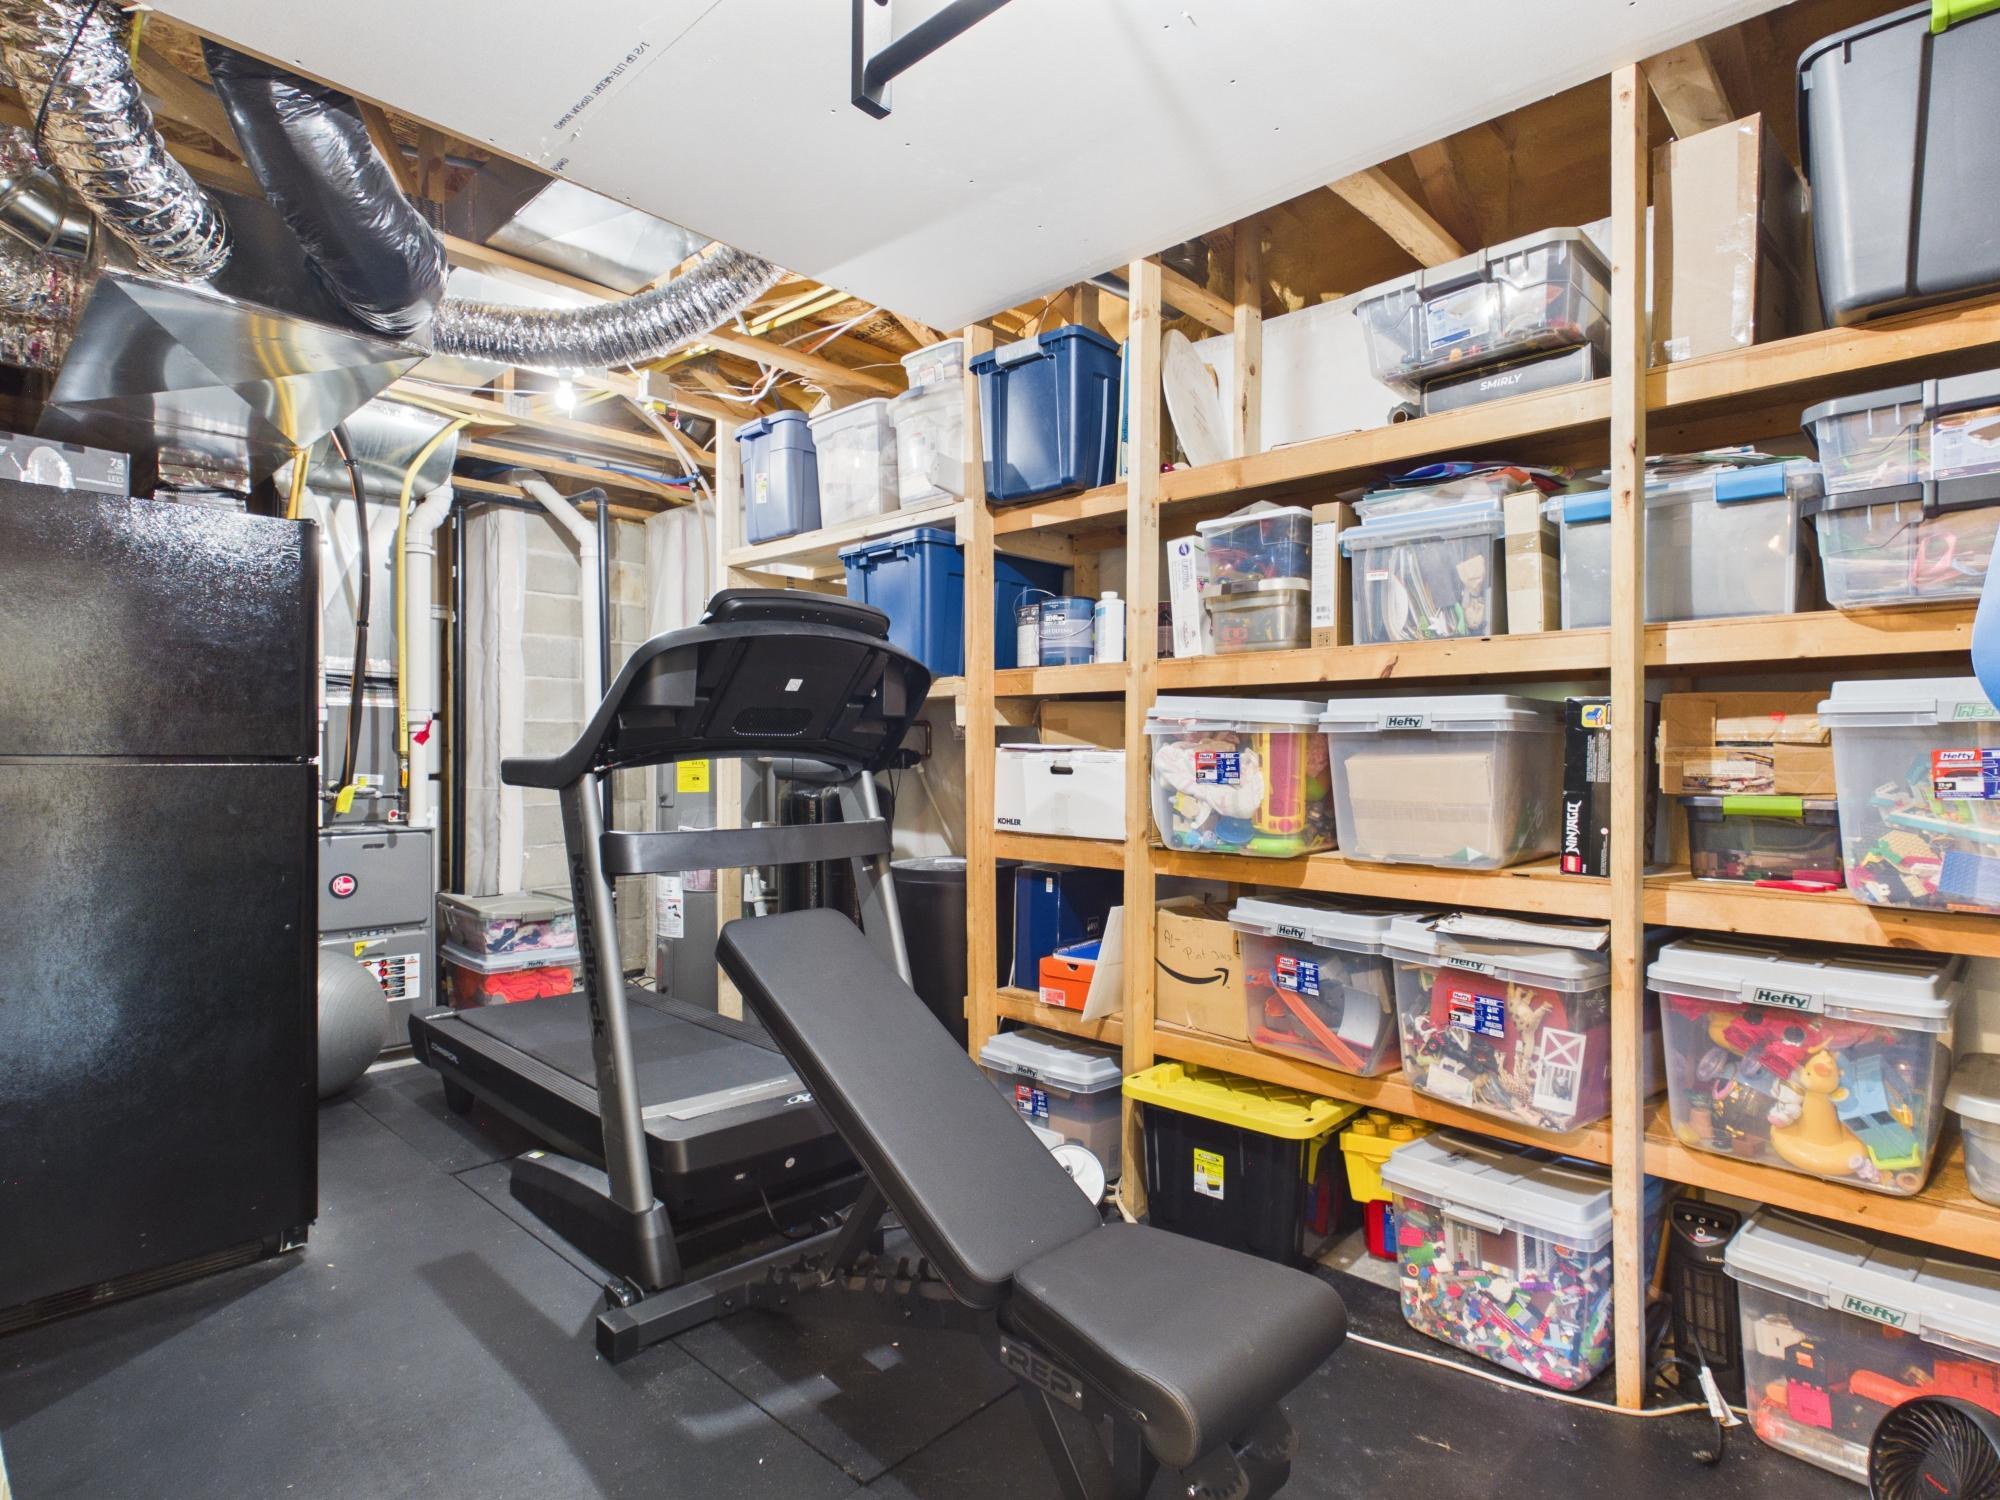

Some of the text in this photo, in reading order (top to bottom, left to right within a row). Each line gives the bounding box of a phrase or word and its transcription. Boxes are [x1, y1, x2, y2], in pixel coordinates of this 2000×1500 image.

[1479, 373, 1523, 391] SMIRLY
[1388, 716, 1421, 729] Hefty
[1942, 752, 1974, 761] Hefty
[997, 817, 1021, 827] KOHLER
[1565, 800, 1583, 856] NINJAGO
[1278, 925, 1304, 939] Hefty
[571, 851, 601, 1038] NordicTrack
[1757, 990, 1807, 1008] Hefty
[1846, 1298, 1901, 1324] Hefty
[1007, 1344, 1073, 1393] REP
